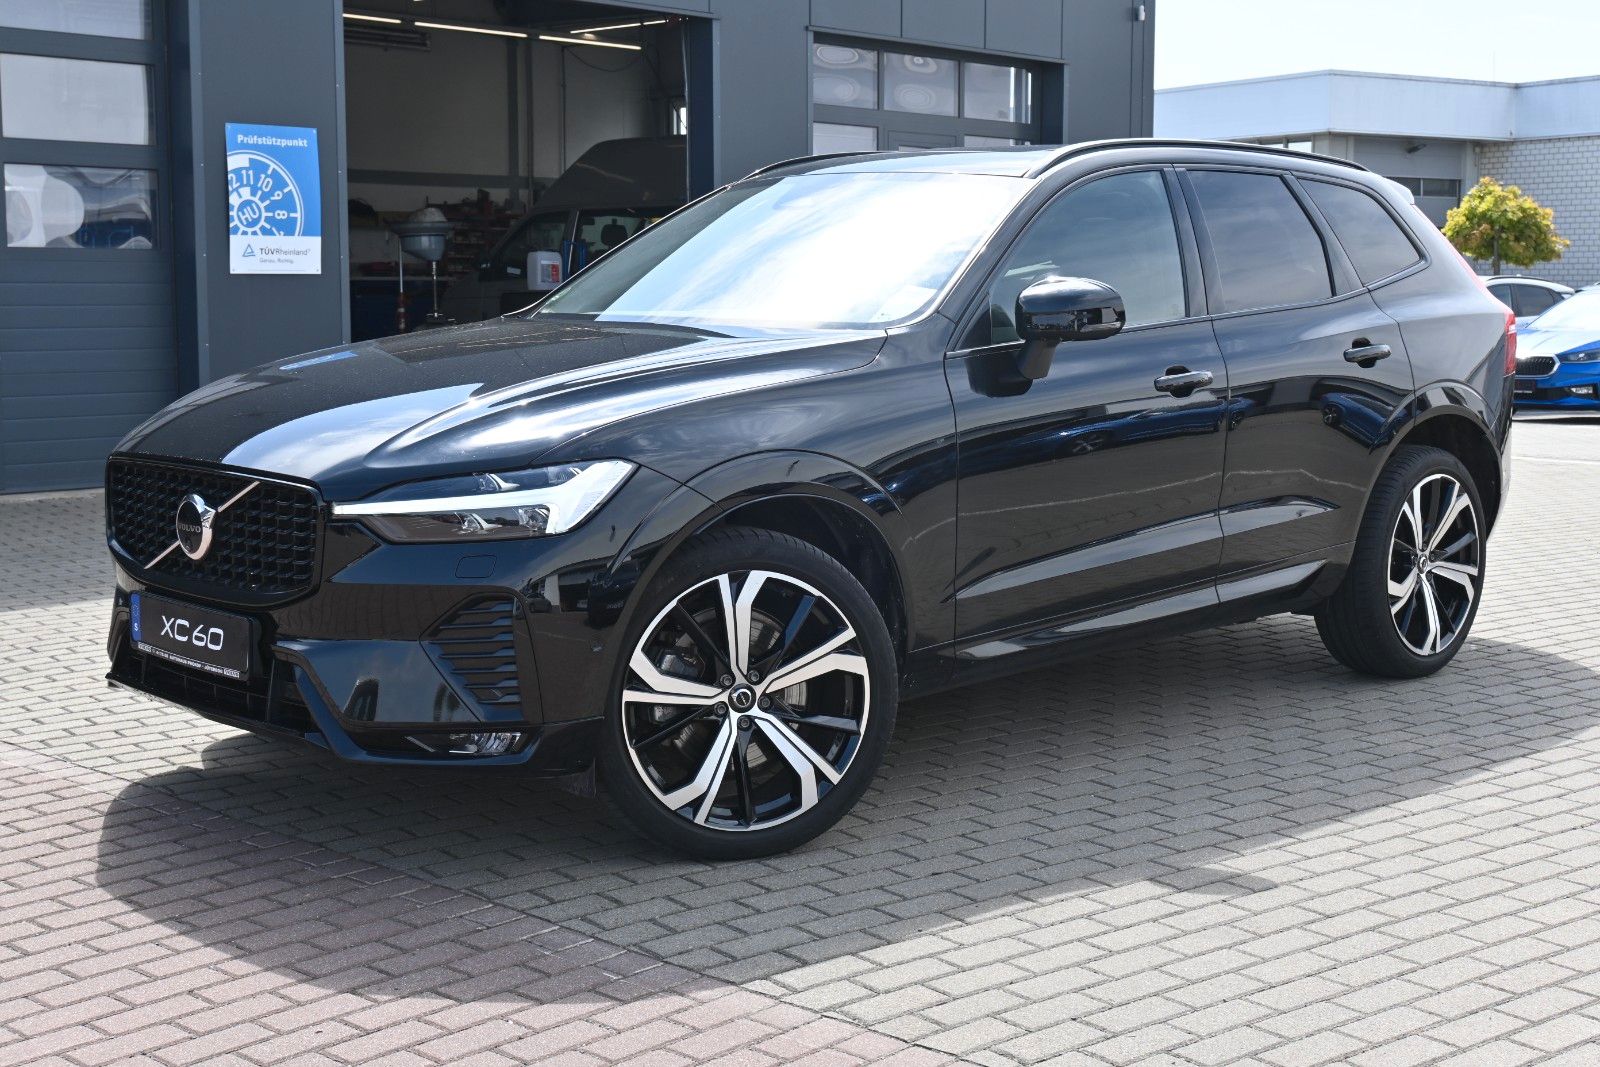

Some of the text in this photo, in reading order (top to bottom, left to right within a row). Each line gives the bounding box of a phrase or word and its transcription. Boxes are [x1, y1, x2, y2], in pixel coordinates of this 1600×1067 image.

[237, 134, 308, 148] Prüfstützpunkt
[241, 169, 254, 185] 11
[257, 174, 273, 192] 10
[270, 190, 283, 201] 9
[238, 202, 260, 226] HU
[274, 210, 288, 220] 8
[178, 523, 202, 533] VOLVO
[134, 622, 139, 632] S
